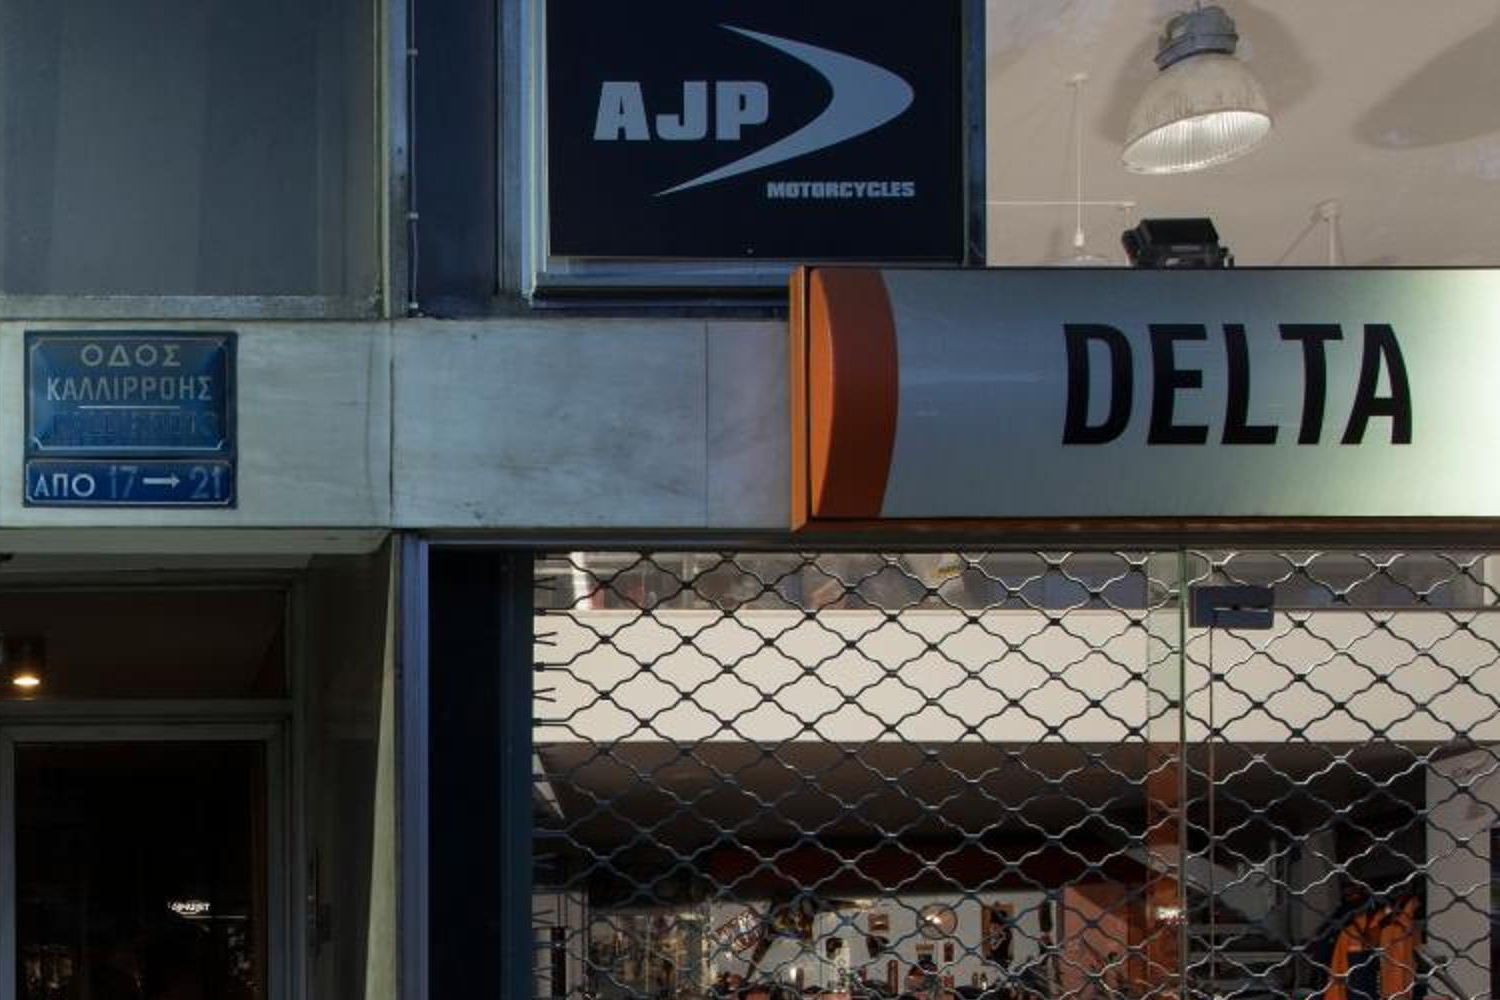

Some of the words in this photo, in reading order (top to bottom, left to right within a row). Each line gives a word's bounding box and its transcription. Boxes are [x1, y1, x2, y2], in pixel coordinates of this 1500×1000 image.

[593, 81, 769, 141] AJP
[767, 181, 916, 199] MOTORCYCLES
[80, 343, 181, 367] ΟΔΟΣ
[46, 375, 213, 401] ΚΑΛΛΙΡΡΟΗΣ
[1061, 322, 1413, 446] DELTA
[33, 473, 96, 497] ΑΠΟ
[108, 465, 138, 499] 17
[188, 466, 221, 499] 21
